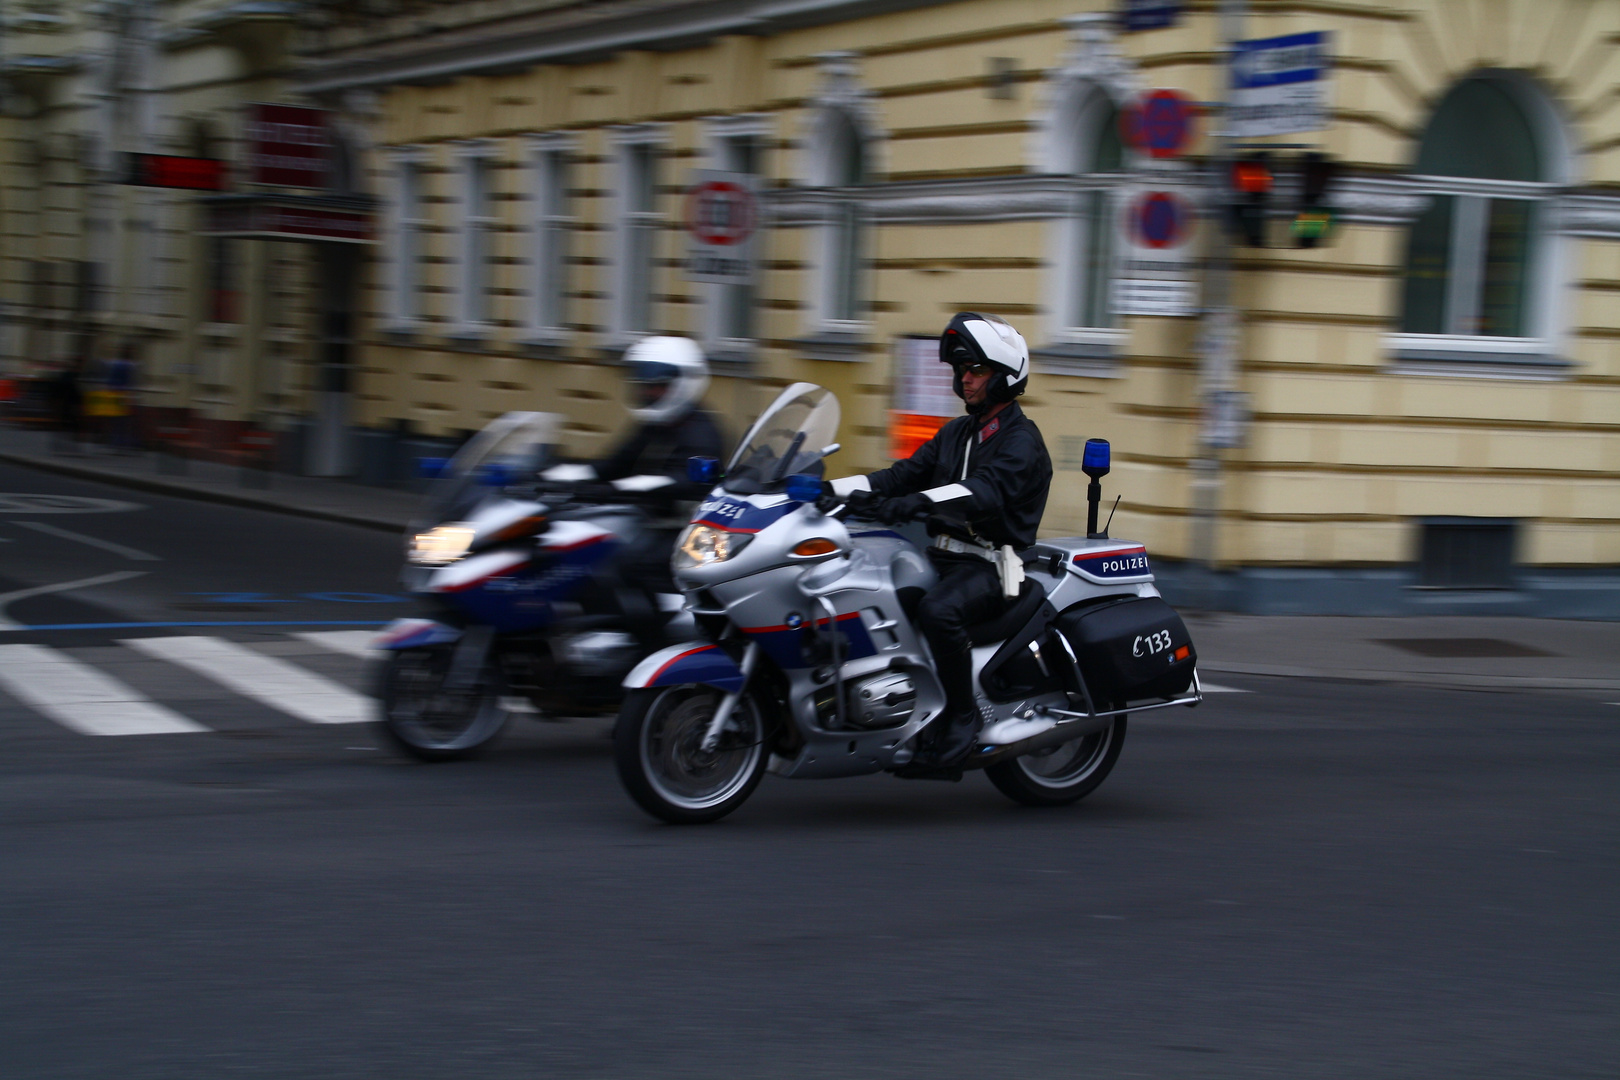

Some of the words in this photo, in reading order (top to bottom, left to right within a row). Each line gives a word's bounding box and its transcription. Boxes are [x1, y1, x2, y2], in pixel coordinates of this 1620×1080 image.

[698, 500, 746, 520] LIZEI
[1102, 557, 1149, 573] POLIZEI
[1144, 629, 1172, 655] 133
